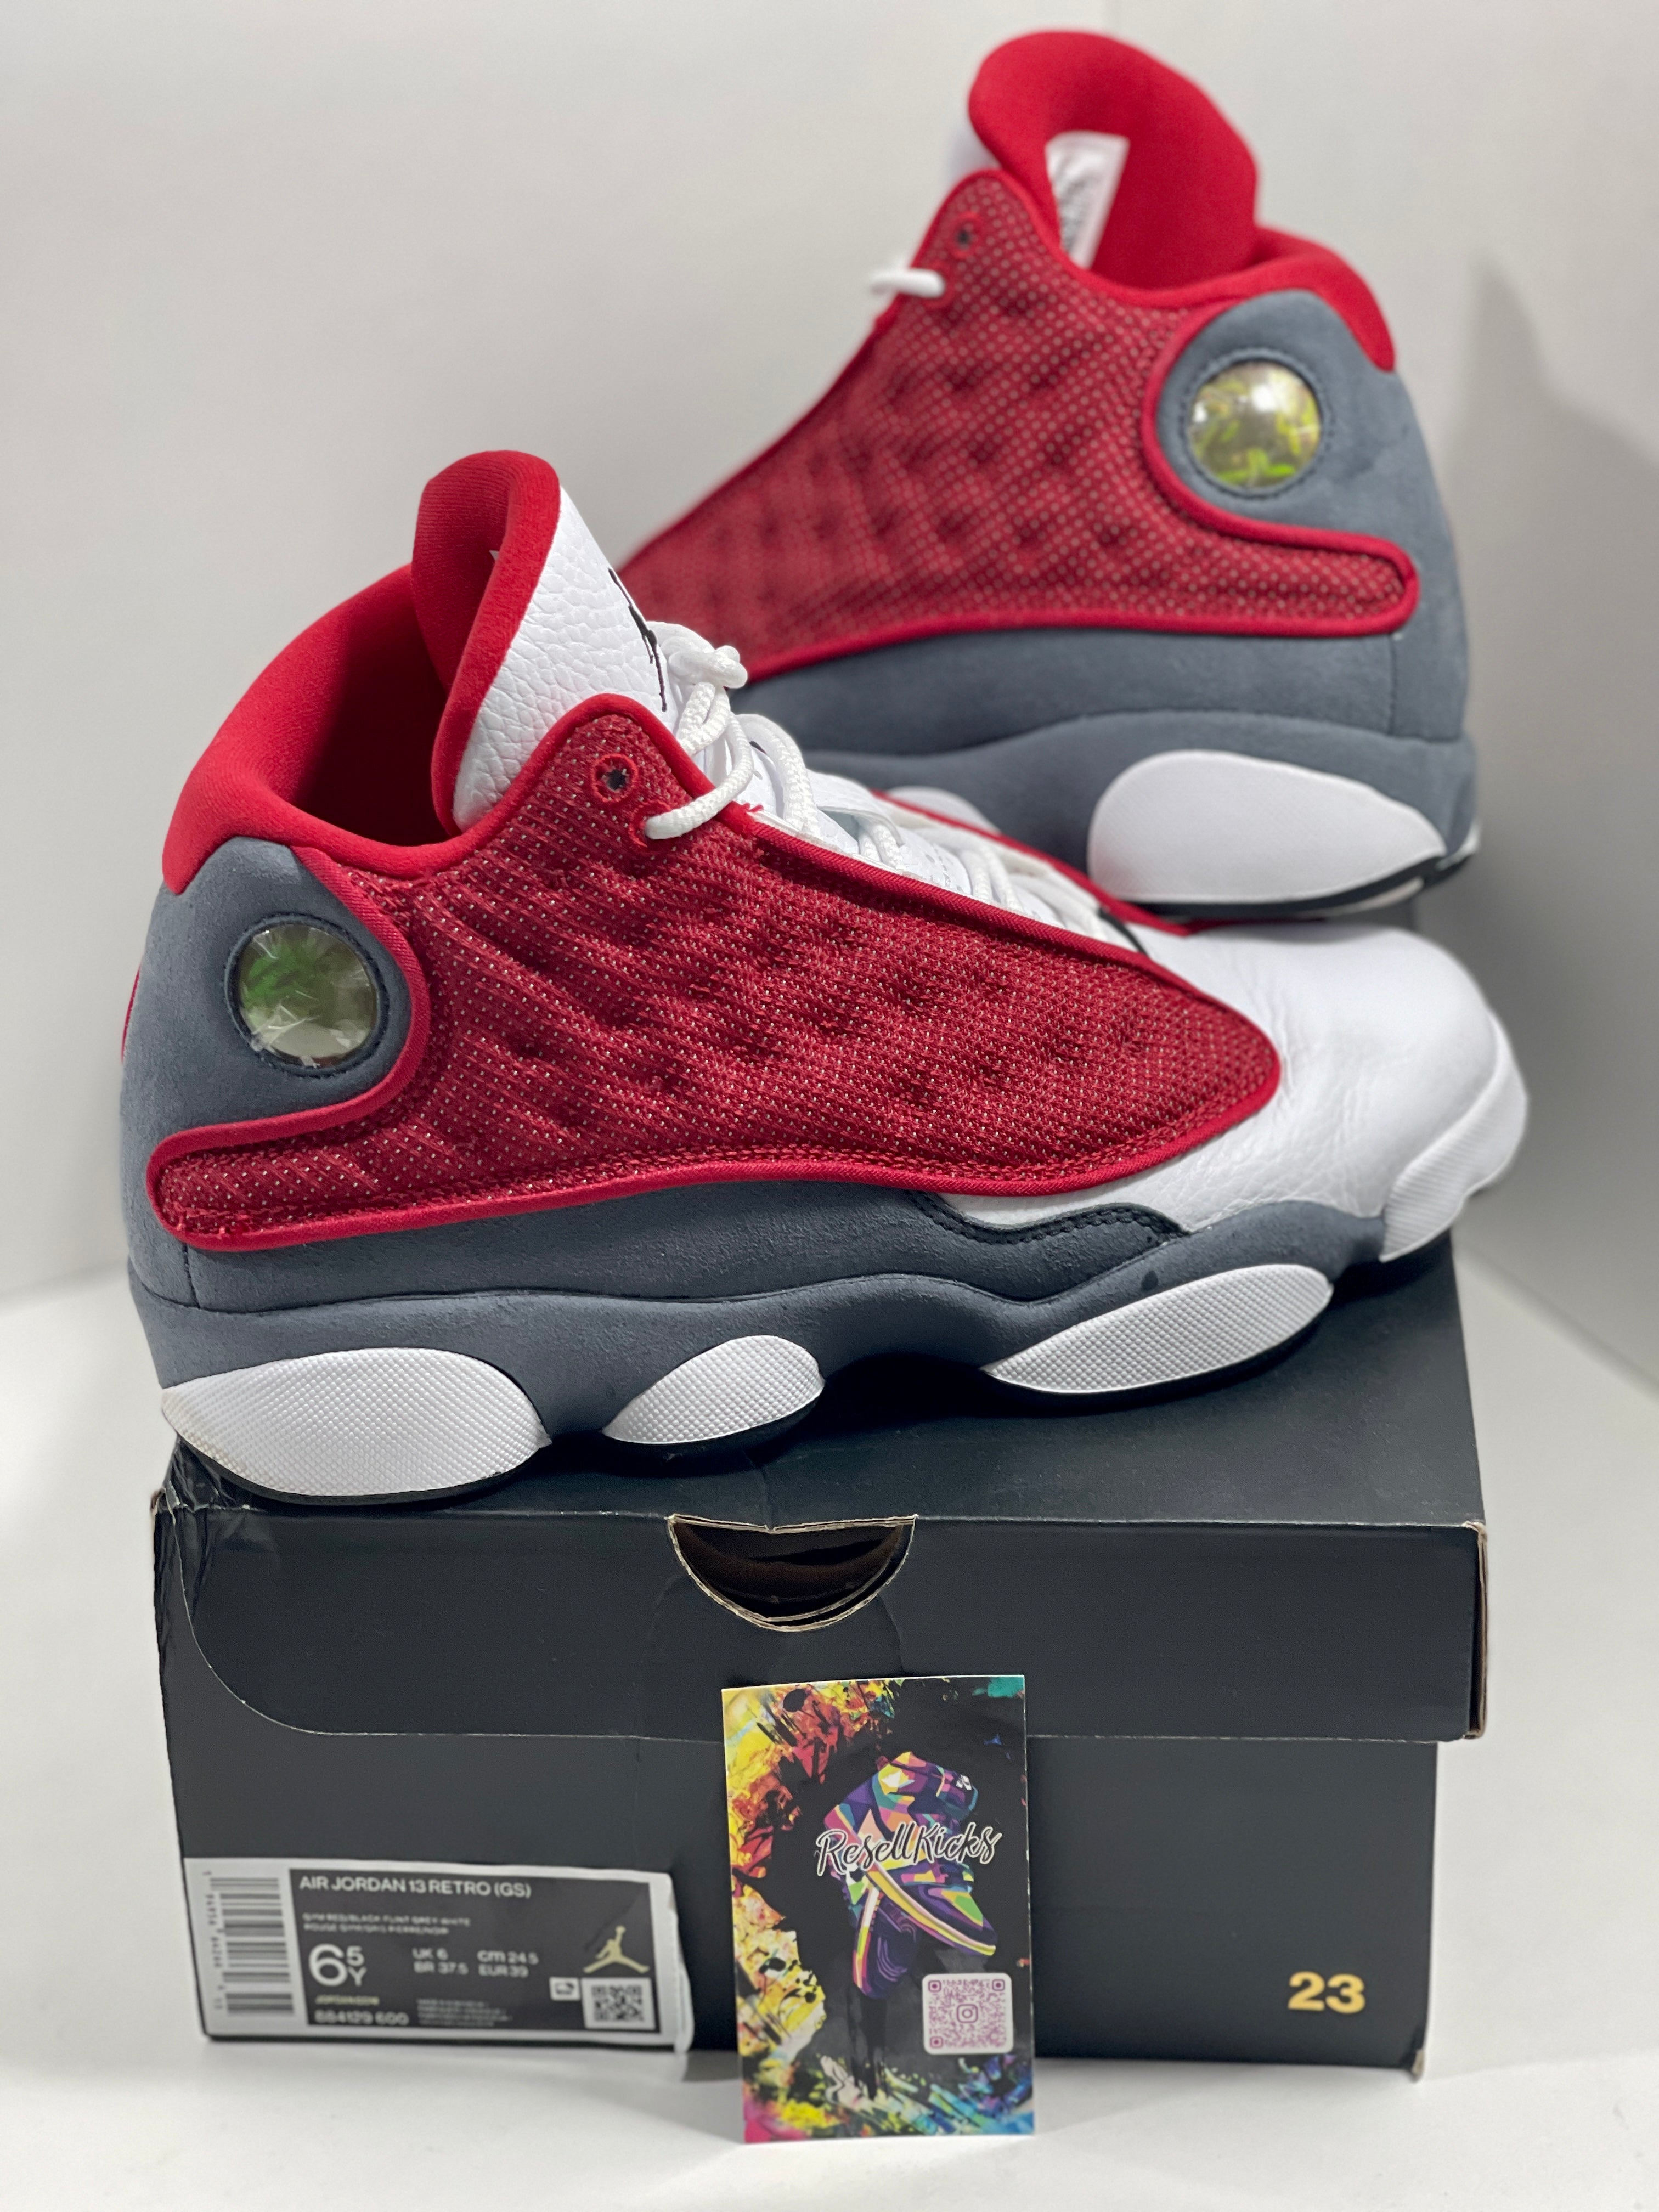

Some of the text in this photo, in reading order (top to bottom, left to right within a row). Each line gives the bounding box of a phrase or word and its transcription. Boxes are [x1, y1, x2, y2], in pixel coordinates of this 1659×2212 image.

[300, 1875, 531, 1899] AIR JORDAN 13 RETRO (GS)
[412, 1948, 433, 1960] UK
[414, 1961, 435, 1973] BR
[478, 1963, 508, 1976] EUR
[1288, 1971, 1365, 2014] 23
